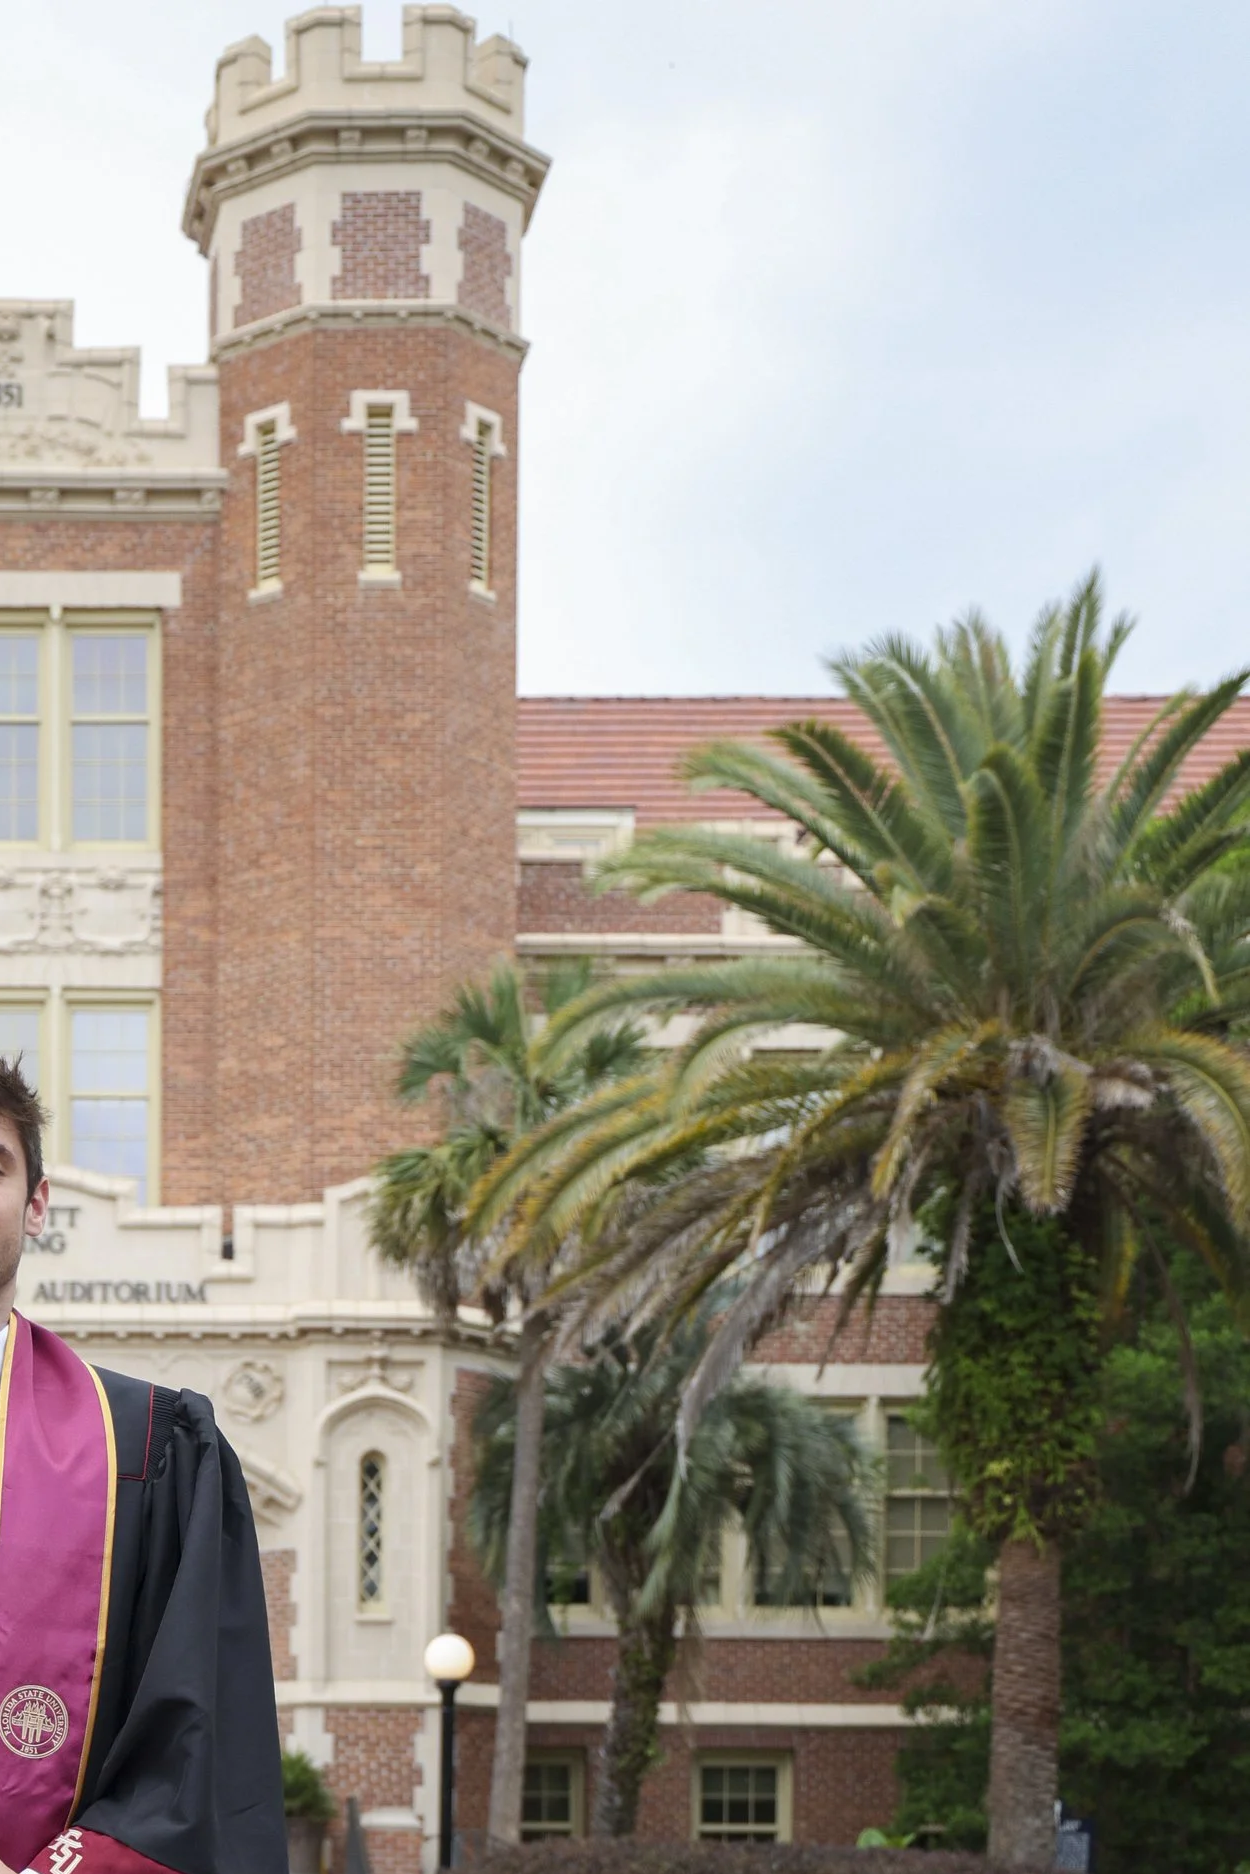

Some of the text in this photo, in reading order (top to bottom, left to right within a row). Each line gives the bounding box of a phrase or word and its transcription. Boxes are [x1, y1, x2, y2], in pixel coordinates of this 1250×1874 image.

[34, 1280, 207, 1303] AUDITORIUM
[2, 1690, 64, 1747] FLORIDA STATE UNIVERSITY
[20, 1745, 38, 1755] 1851
